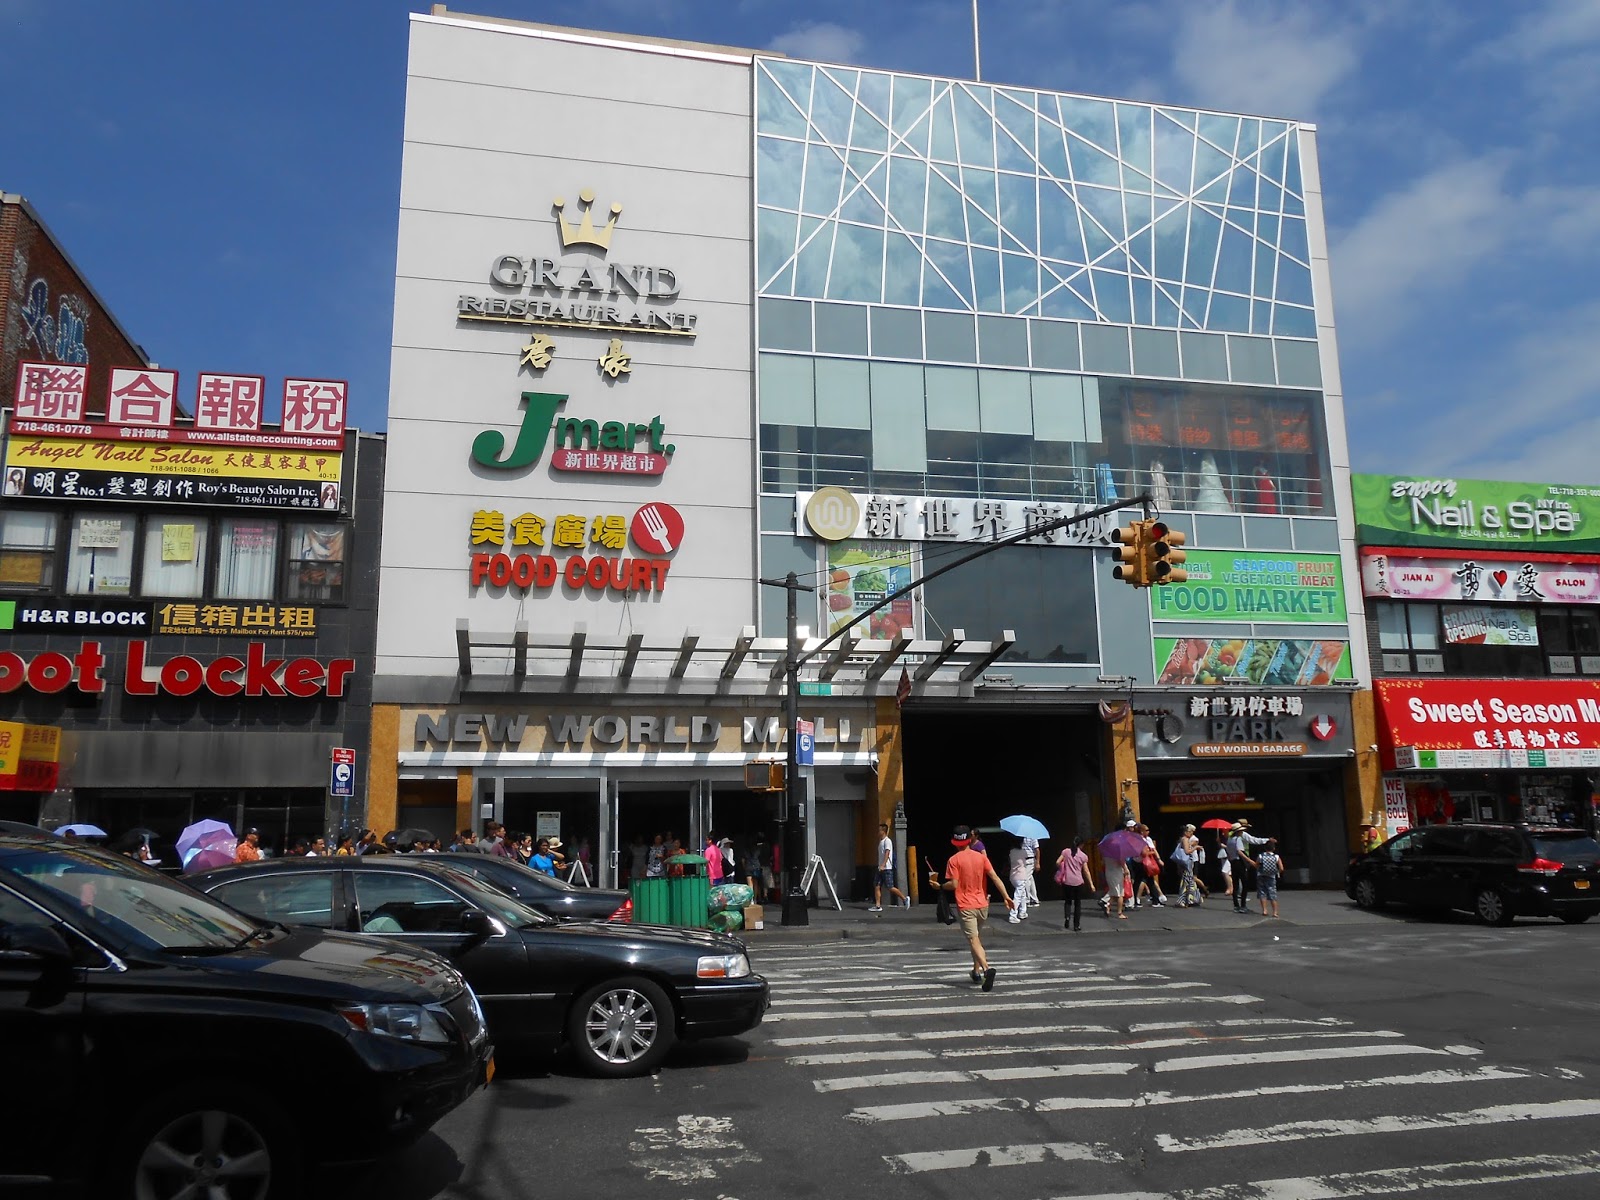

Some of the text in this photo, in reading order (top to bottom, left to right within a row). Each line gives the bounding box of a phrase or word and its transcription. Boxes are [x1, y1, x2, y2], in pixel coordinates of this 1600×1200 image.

[491, 255, 681, 297] GRAND
[458, 295, 697, 331] RESTAURANT
[17, 366, 343, 435] 聯合報稅
[17, 422, 92, 435] 718-461-0778
[187, 432, 337, 447] www.allstateaccounting.com
[17, 439, 213, 465] Angel Nail Salon
[150, 465, 197, 474] 718-961-1088
[223, 452, 327, 473] 天使美容美甲
[565, 452, 656, 472] 新世界超市
[33, 471, 81, 495] 明星
[80, 486, 104, 497] No.1
[198, 482, 318, 497] Roy's Beauty Salon Inc.
[235, 495, 287, 505] 718-961-1117
[1411, 497, 1575, 535] Nail & Spa
[471, 510, 627, 549] 美食廣場
[471, 553, 671, 592] FOOD COURT
[1175, 562, 1212, 573] mart
[1233, 559, 1335, 573] SEAFOOD FRUIT
[1222, 573, 1336, 586] VEGETABLE MEAT
[1402, 573, 1422, 581] JIAN
[1517, 564, 1546, 598] 愛
[1556, 579, 1585, 587] SALON
[1159, 586, 1337, 614] FOOD MARKET
[22, 609, 146, 625] H&R BLOCK
[159, 603, 316, 628] 信箱出租
[1443, 607, 1484, 629] GRAND
[1489, 618, 1519, 629] Nail &
[1446, 620, 1488, 643] OPENING
[1508, 630, 1532, 643] Spa
[125, 640, 356, 697] Locker
[1553, 661, 1573, 669] NAIL
[803, 685, 819, 693] MAIN
[1190, 696, 1304, 717] 新世界停車場
[1408, 697, 1488, 723] Sweet
[1489, 697, 1577, 723] Season
[415, 713, 866, 744] NEW WORLD MLL
[1210, 718, 1287, 741] PARK
[1473, 728, 1581, 749] 旺季購物中心
[1196, 745, 1303, 754] NEW WORLD GARAGE
[1203, 781, 1243, 792] NO VAN
[1385, 779, 1402, 791] WE
[1175, 795, 1221, 803] CLEARANCE
[1386, 793, 1404, 805] BUY
[1387, 807, 1407, 819] GOLD
